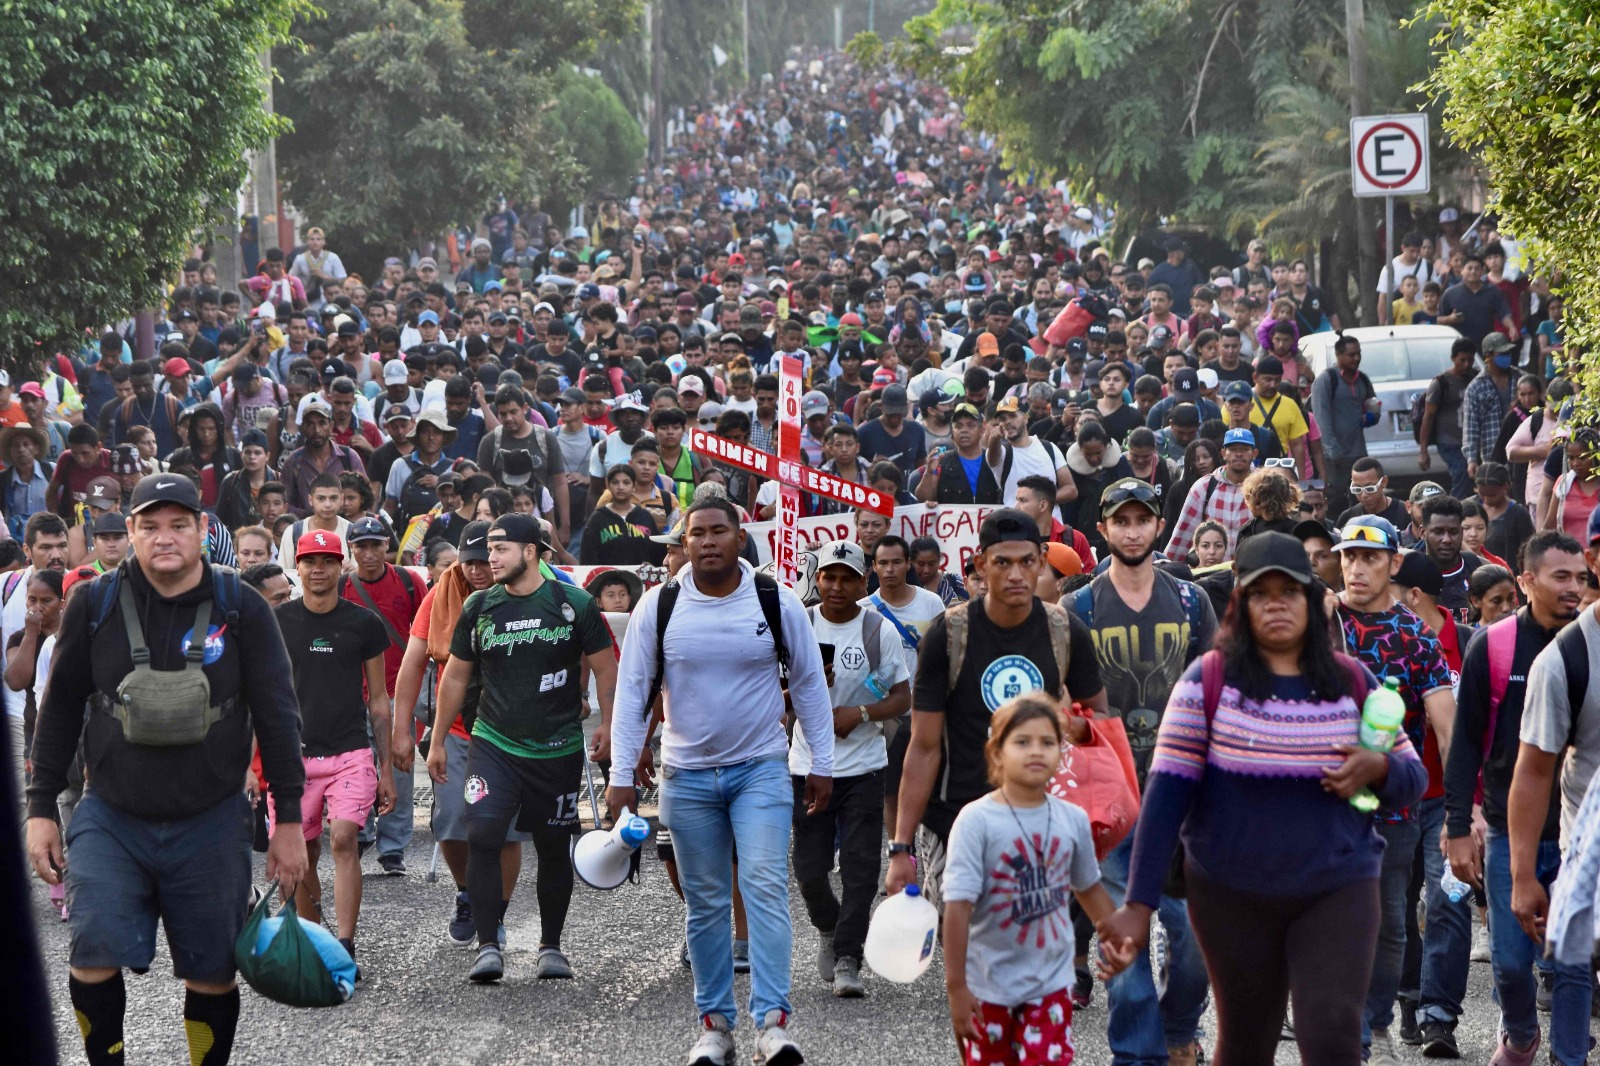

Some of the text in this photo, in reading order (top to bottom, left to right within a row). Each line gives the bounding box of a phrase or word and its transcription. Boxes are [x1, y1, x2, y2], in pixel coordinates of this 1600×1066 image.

[1374, 134, 1407, 176] E
[785, 379, 798, 417] 40
[694, 432, 881, 508] CRIMEN DE ESTADO
[184, 635, 223, 650] NSA
[539, 668, 568, 692] 20
[556, 791, 578, 819] 13
